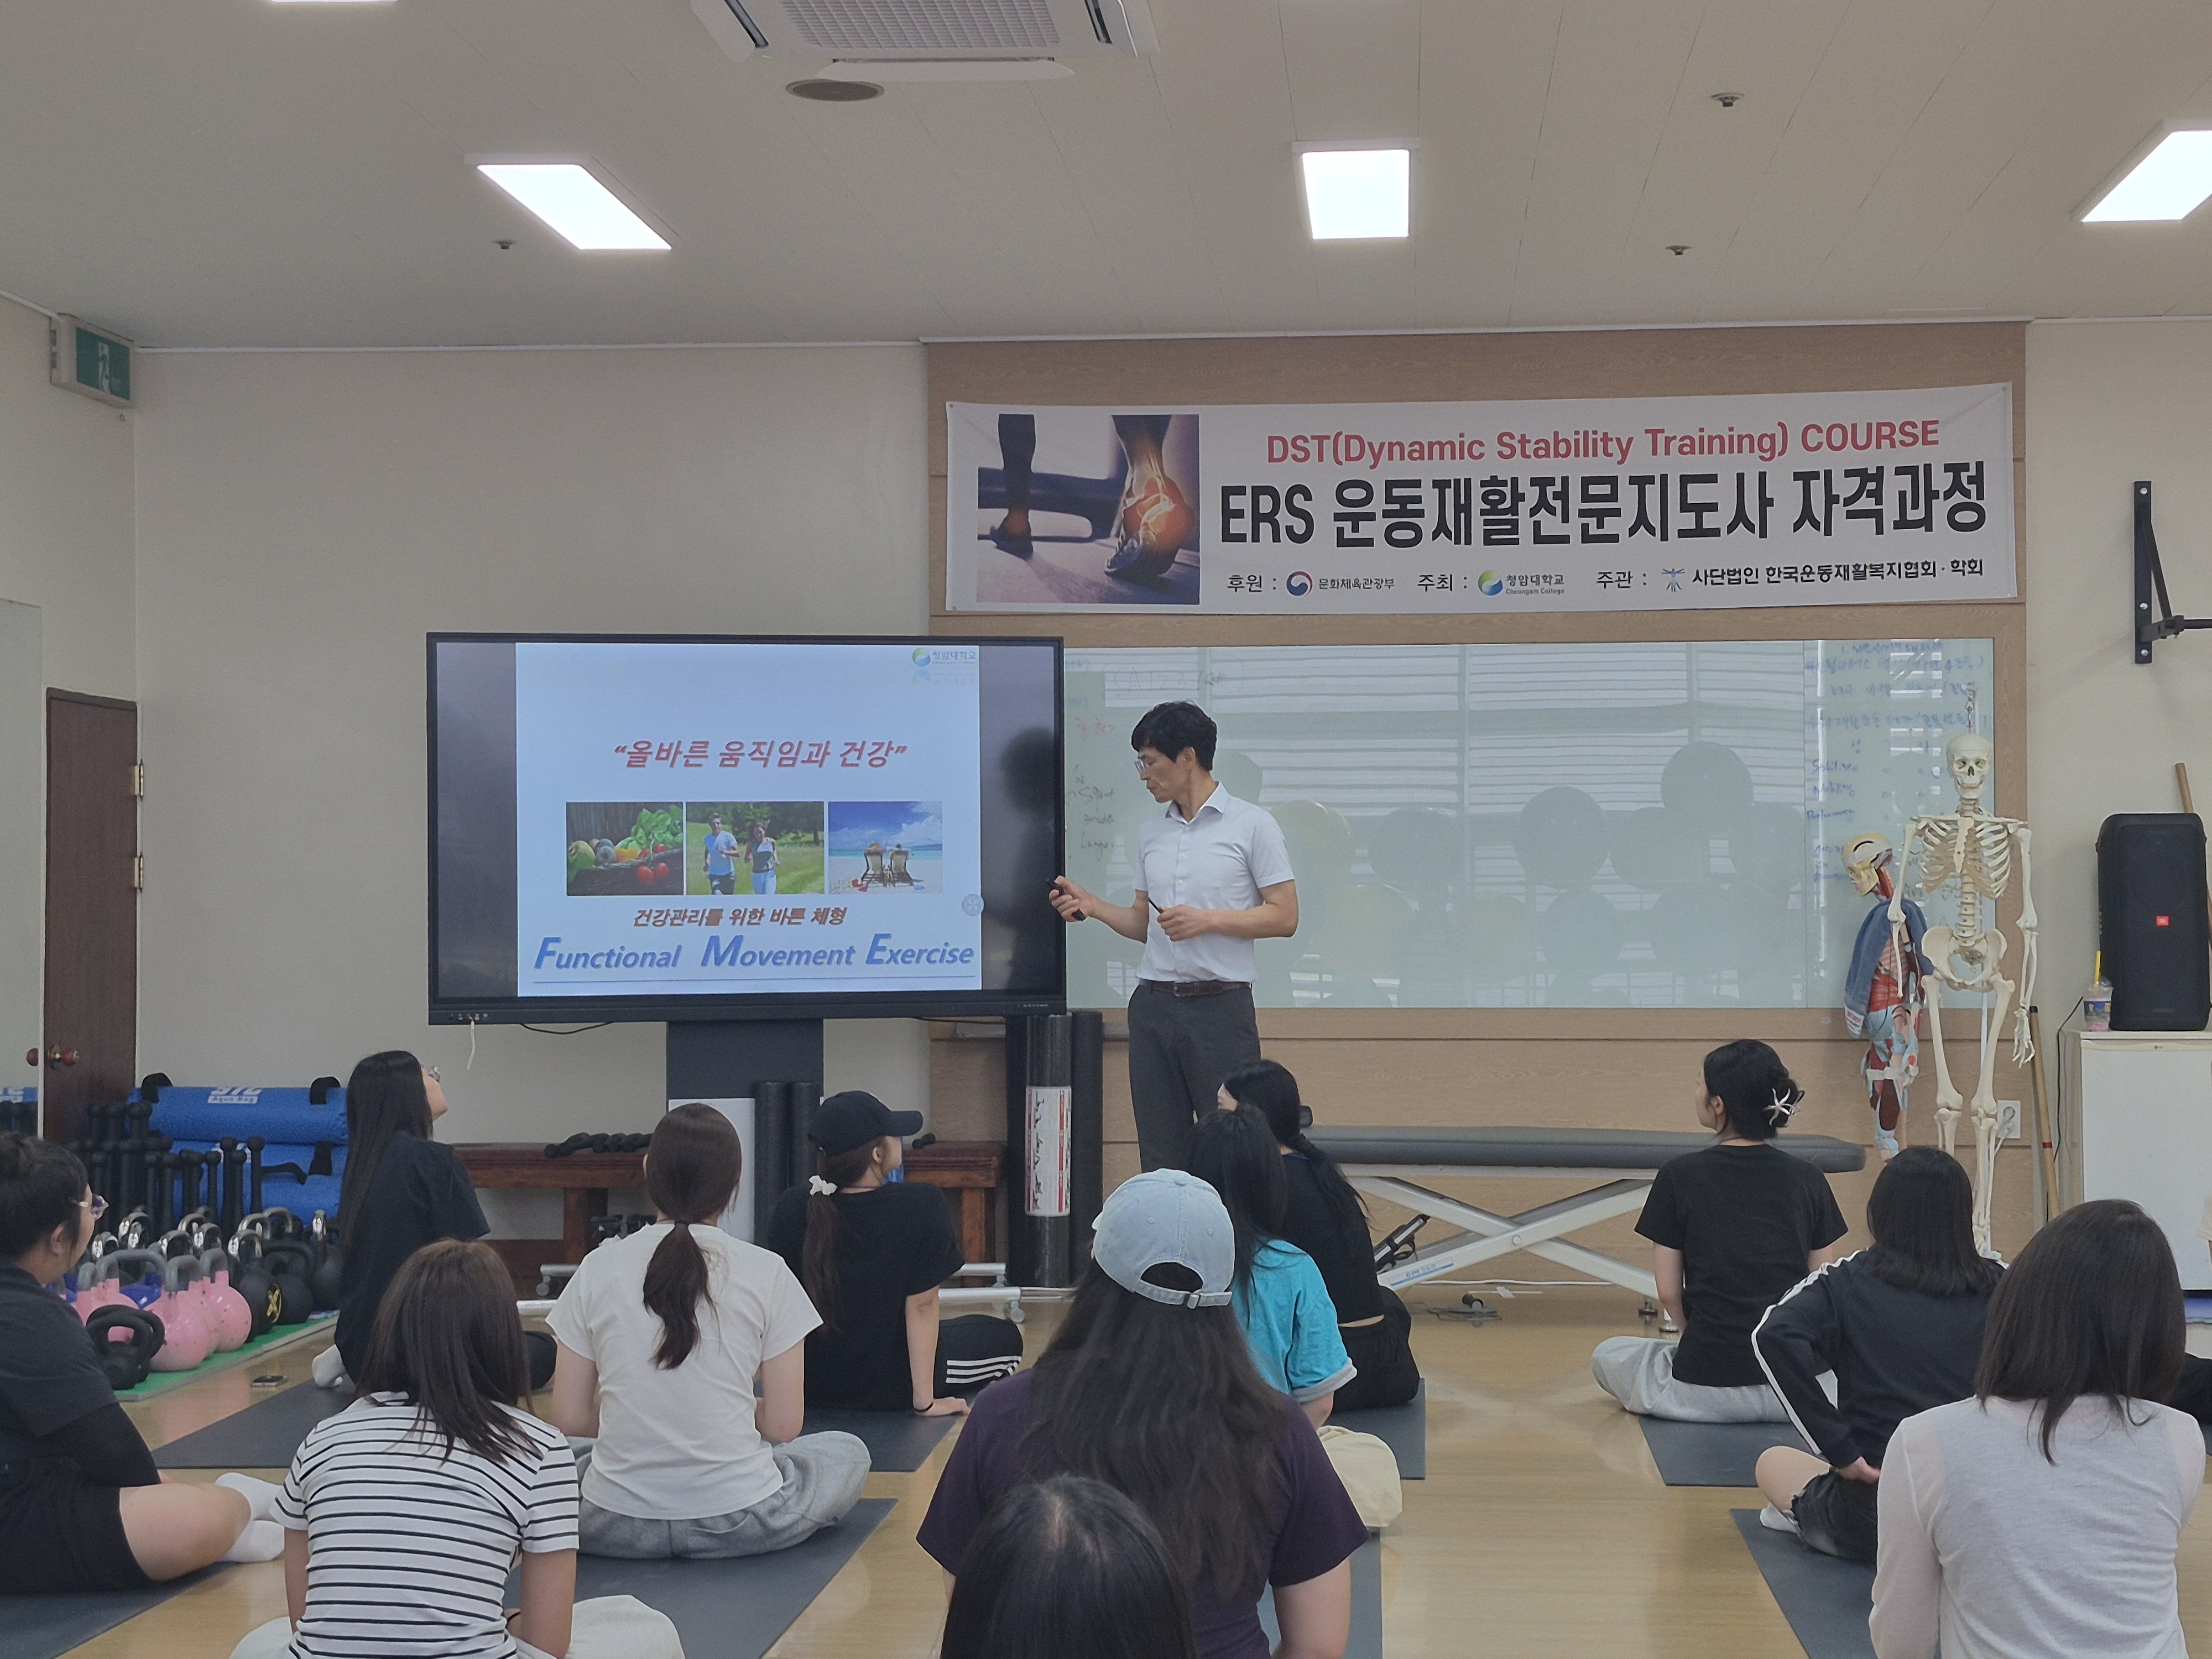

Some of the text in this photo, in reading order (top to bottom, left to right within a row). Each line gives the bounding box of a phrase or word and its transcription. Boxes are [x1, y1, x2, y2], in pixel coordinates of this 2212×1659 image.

[1267, 420, 1940, 471] DST(Dynamic Stability Training) COURSE
[1221, 461, 1987, 548] ERS 운동재활전문지도사 자격과정
[1227, 575, 1263, 593] 후원
[1319, 578, 1395, 591] 문화체육관광부
[1418, 575, 1453, 593] 주최
[1506, 574, 1565, 587] 청암대학교
[1597, 571, 1633, 590] 주관
[1692, 567, 1760, 587] 사단법인
[719, 740, 831, 769] 움직임과
[634, 907, 848, 928] 건강관리를 위한 바른 체형
[534, 933, 975, 970] Functional Movement Exercise
